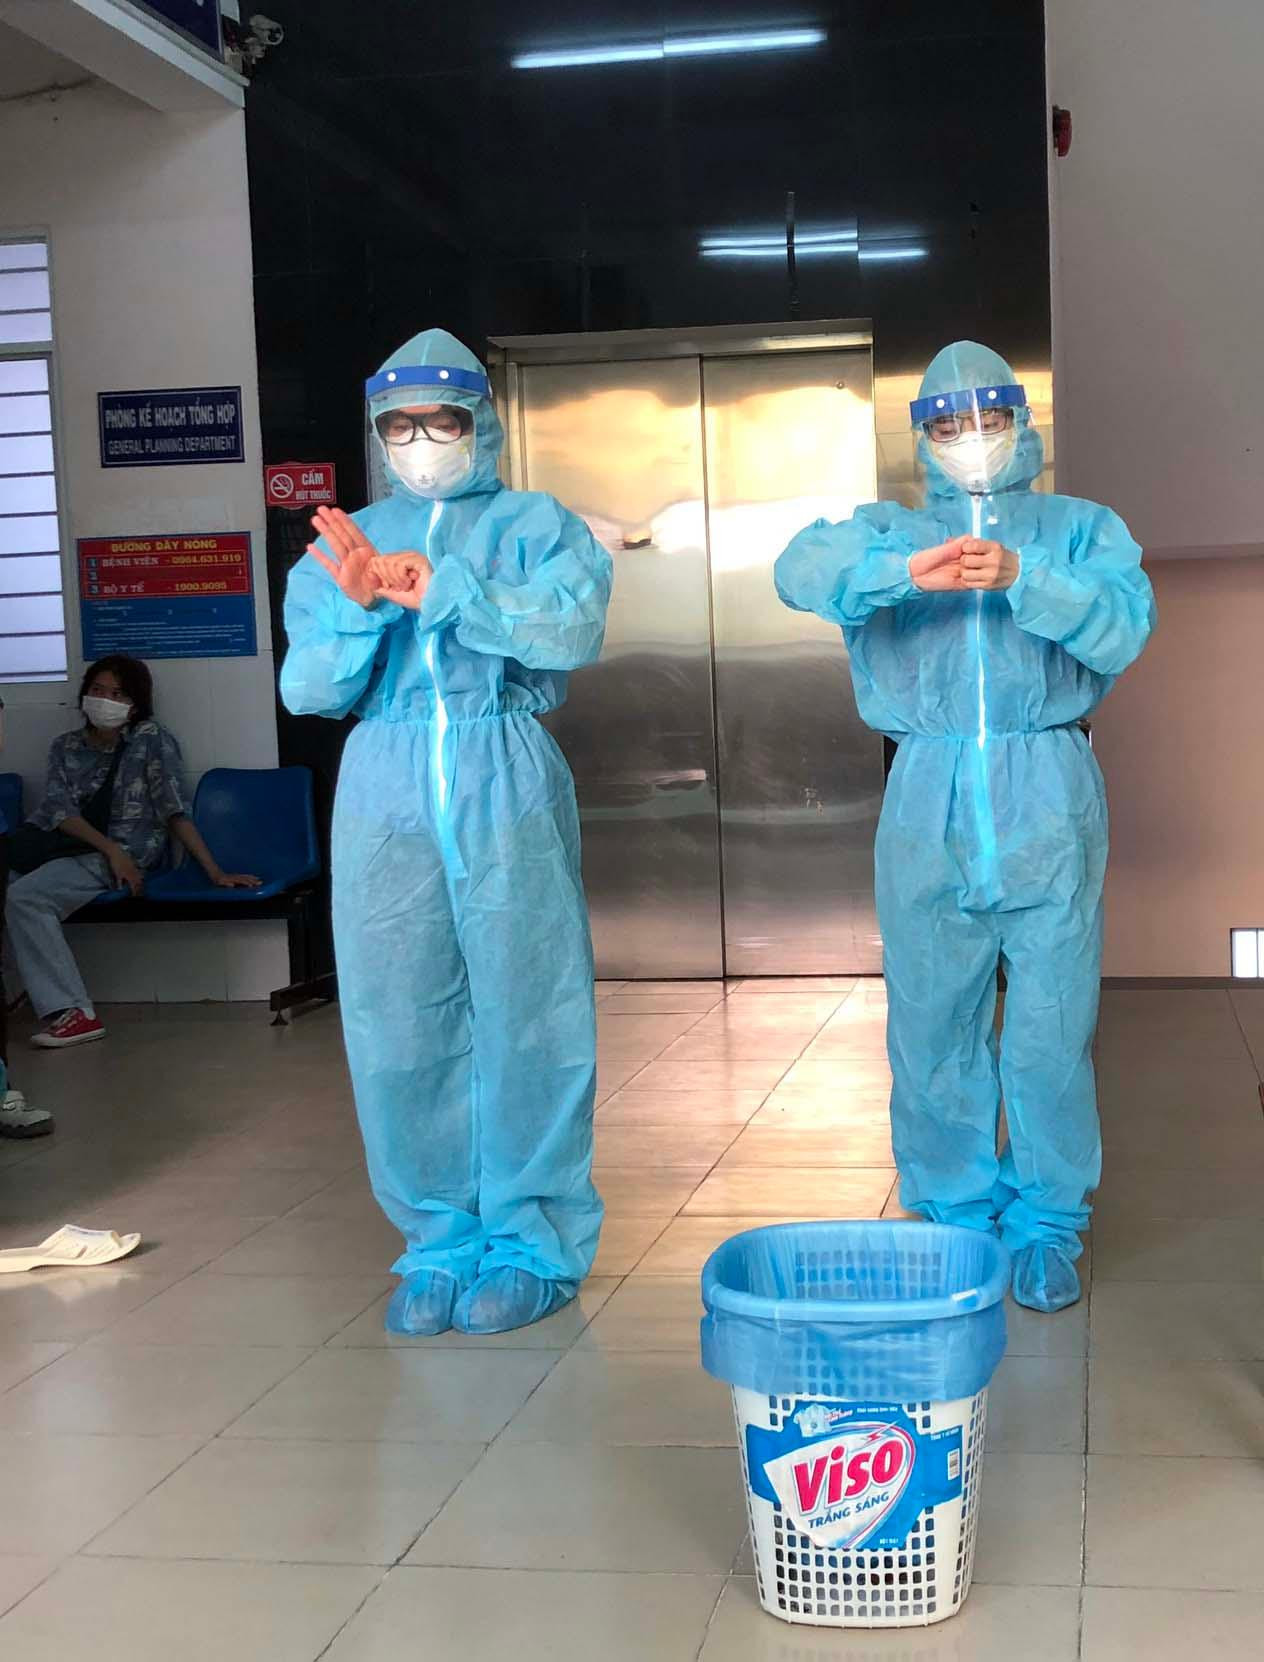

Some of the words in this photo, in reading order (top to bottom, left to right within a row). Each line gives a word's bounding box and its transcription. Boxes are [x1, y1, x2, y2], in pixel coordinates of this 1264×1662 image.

[105, 403, 136, 429] PHÒNG
[138, 402, 152, 427] KẾ
[155, 406, 186, 431] HOẠCH
[188, 396, 214, 424] TỔNG
[216, 401, 235, 429] HỢP
[108, 439, 144, 455] GENERAL
[145, 437, 183, 453] PLANNING
[185, 435, 236, 452] DEPARTMENT
[302, 469, 324, 485] CẤM
[808, 1505, 851, 1529] TRẮNG
[855, 1491, 889, 1513] SÁNG
